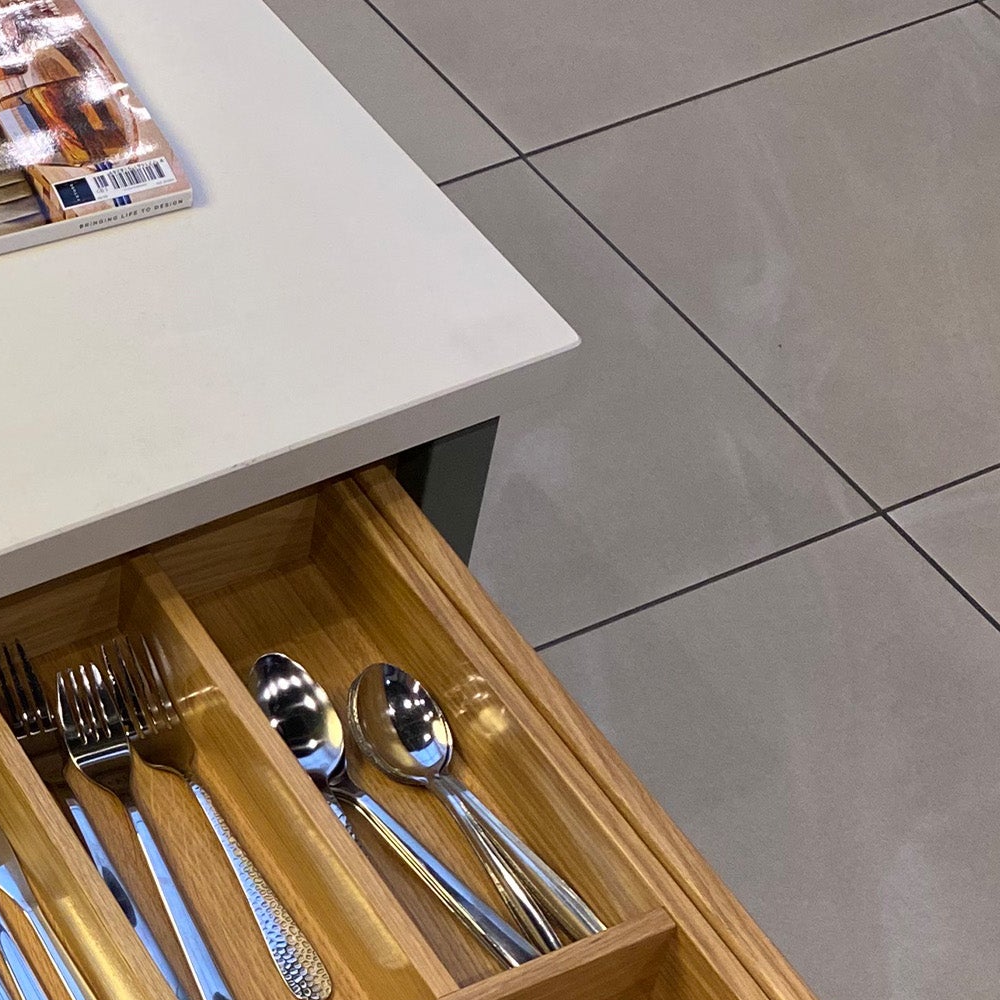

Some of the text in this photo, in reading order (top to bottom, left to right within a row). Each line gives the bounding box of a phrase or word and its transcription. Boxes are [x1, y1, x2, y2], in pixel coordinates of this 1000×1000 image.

[79, 216, 118, 229] BRINGING
[121, 210, 138, 219] LIFE
[154, 199, 183, 210] DESIGN
